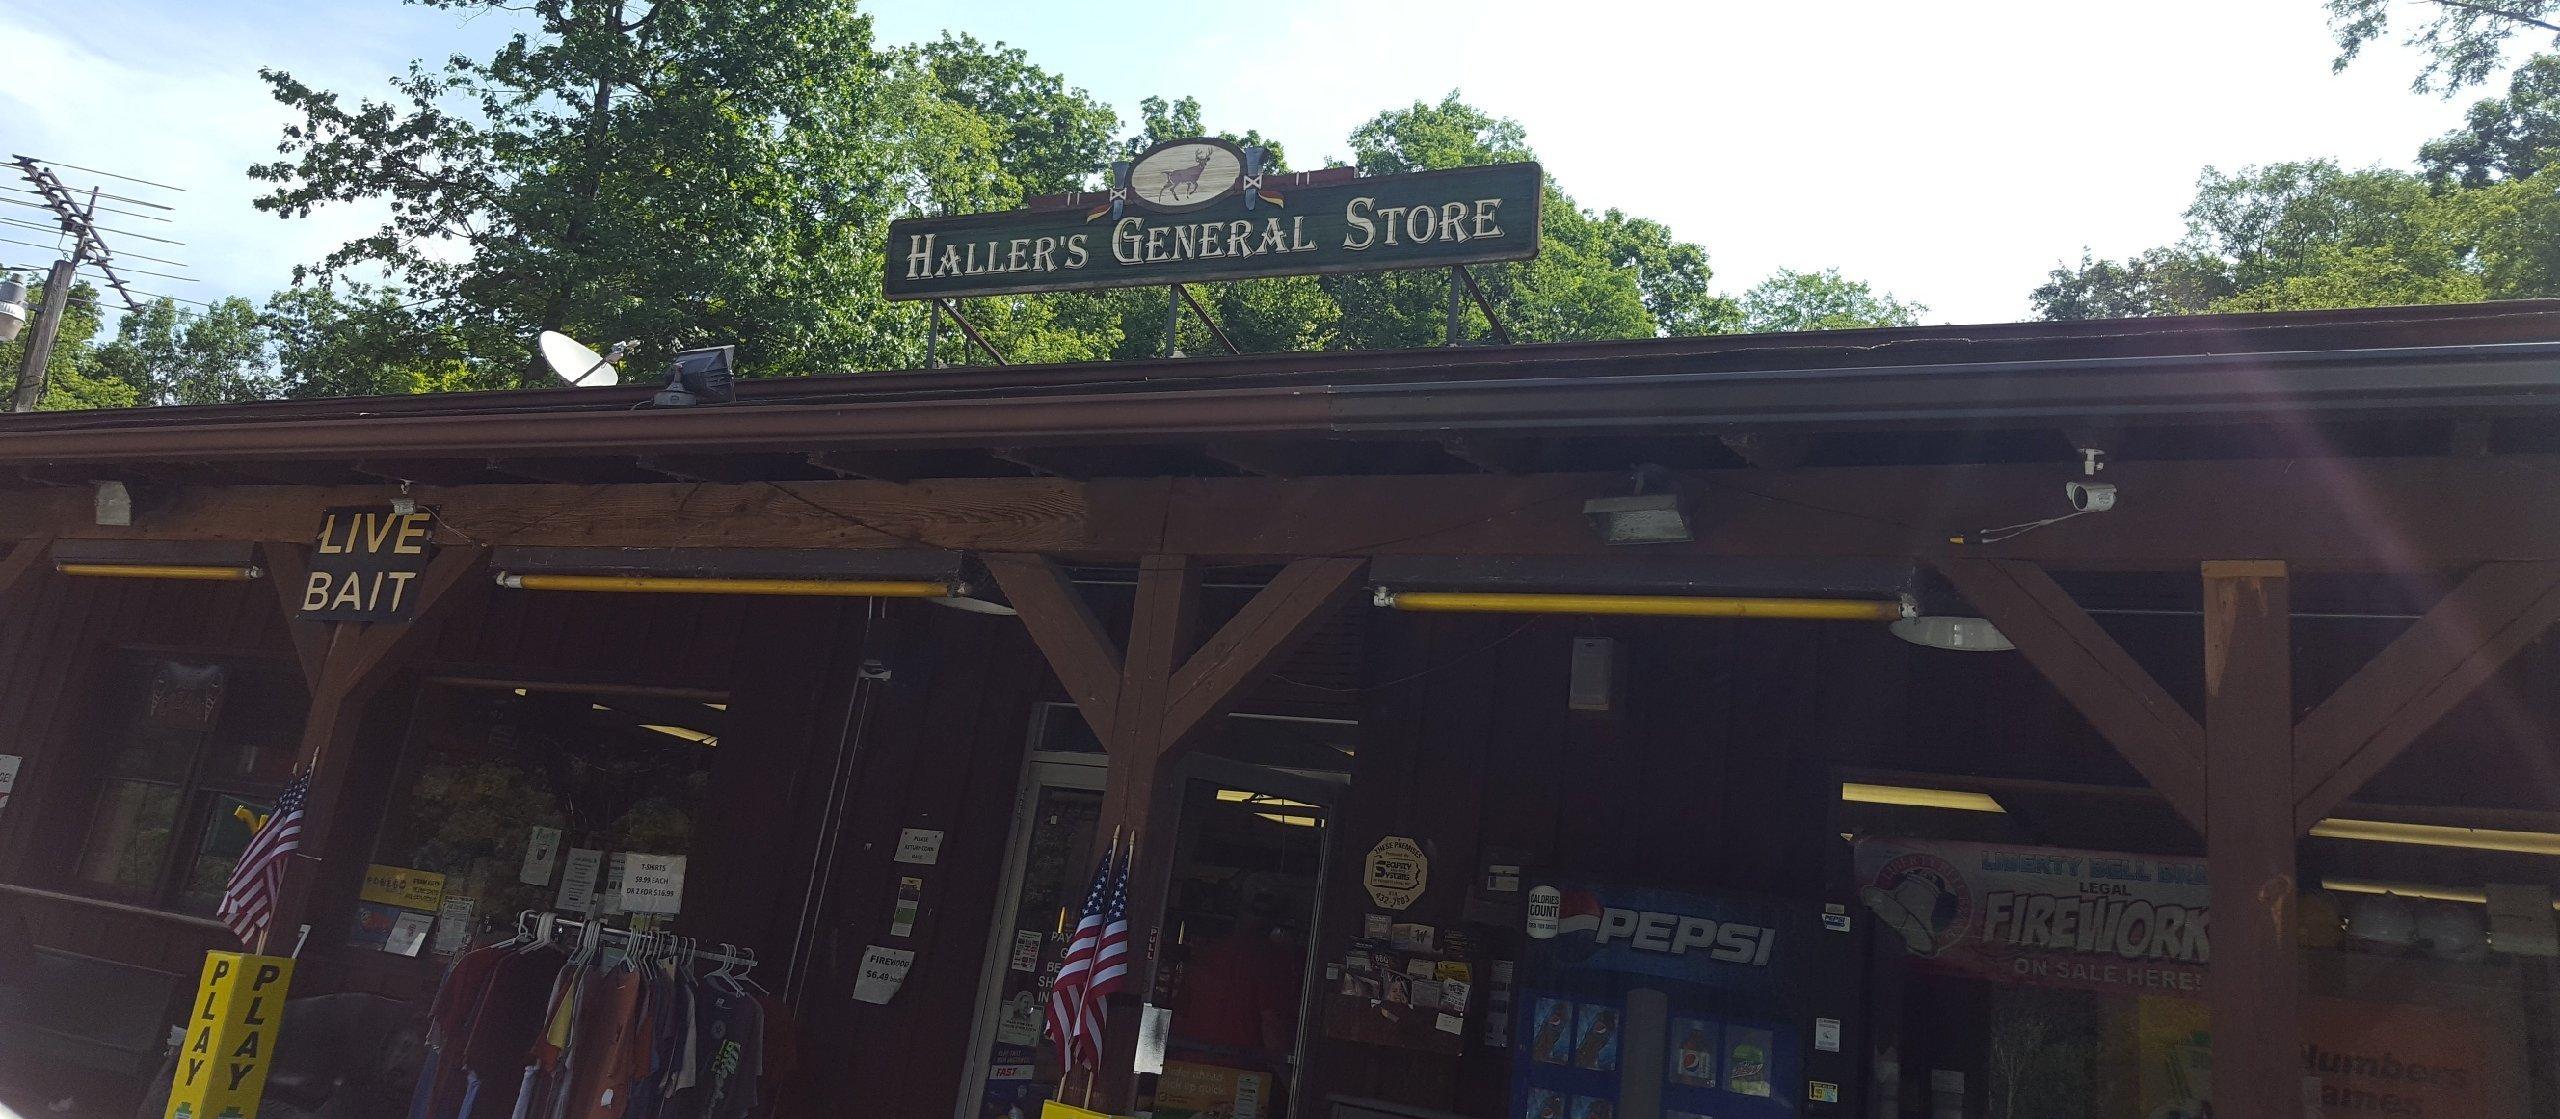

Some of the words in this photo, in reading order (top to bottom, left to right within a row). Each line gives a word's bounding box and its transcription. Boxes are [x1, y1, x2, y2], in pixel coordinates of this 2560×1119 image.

[906, 232, 1088, 281] HALLER'S
[1111, 216, 1317, 266] GENERAL
[1342, 196, 1504, 251] STORE
[318, 512, 432, 554] LIVE
[301, 571, 417, 613] BAIT
[1530, 894, 1560, 906] CALORIES
[2079, 881, 2132, 897] LEGAL
[1529, 904, 1559, 918] COUNT
[1981, 890, 2210, 967] FIREWORK
[1596, 906, 1776, 966] PEPSI
[870, 954, 910, 968] FIREWOOD
[2013, 958, 2049, 977] ON
[2056, 963, 2118, 983] SALE
[184, 960, 230, 1087] PLAY
[227, 964, 281, 1091] PLAY
